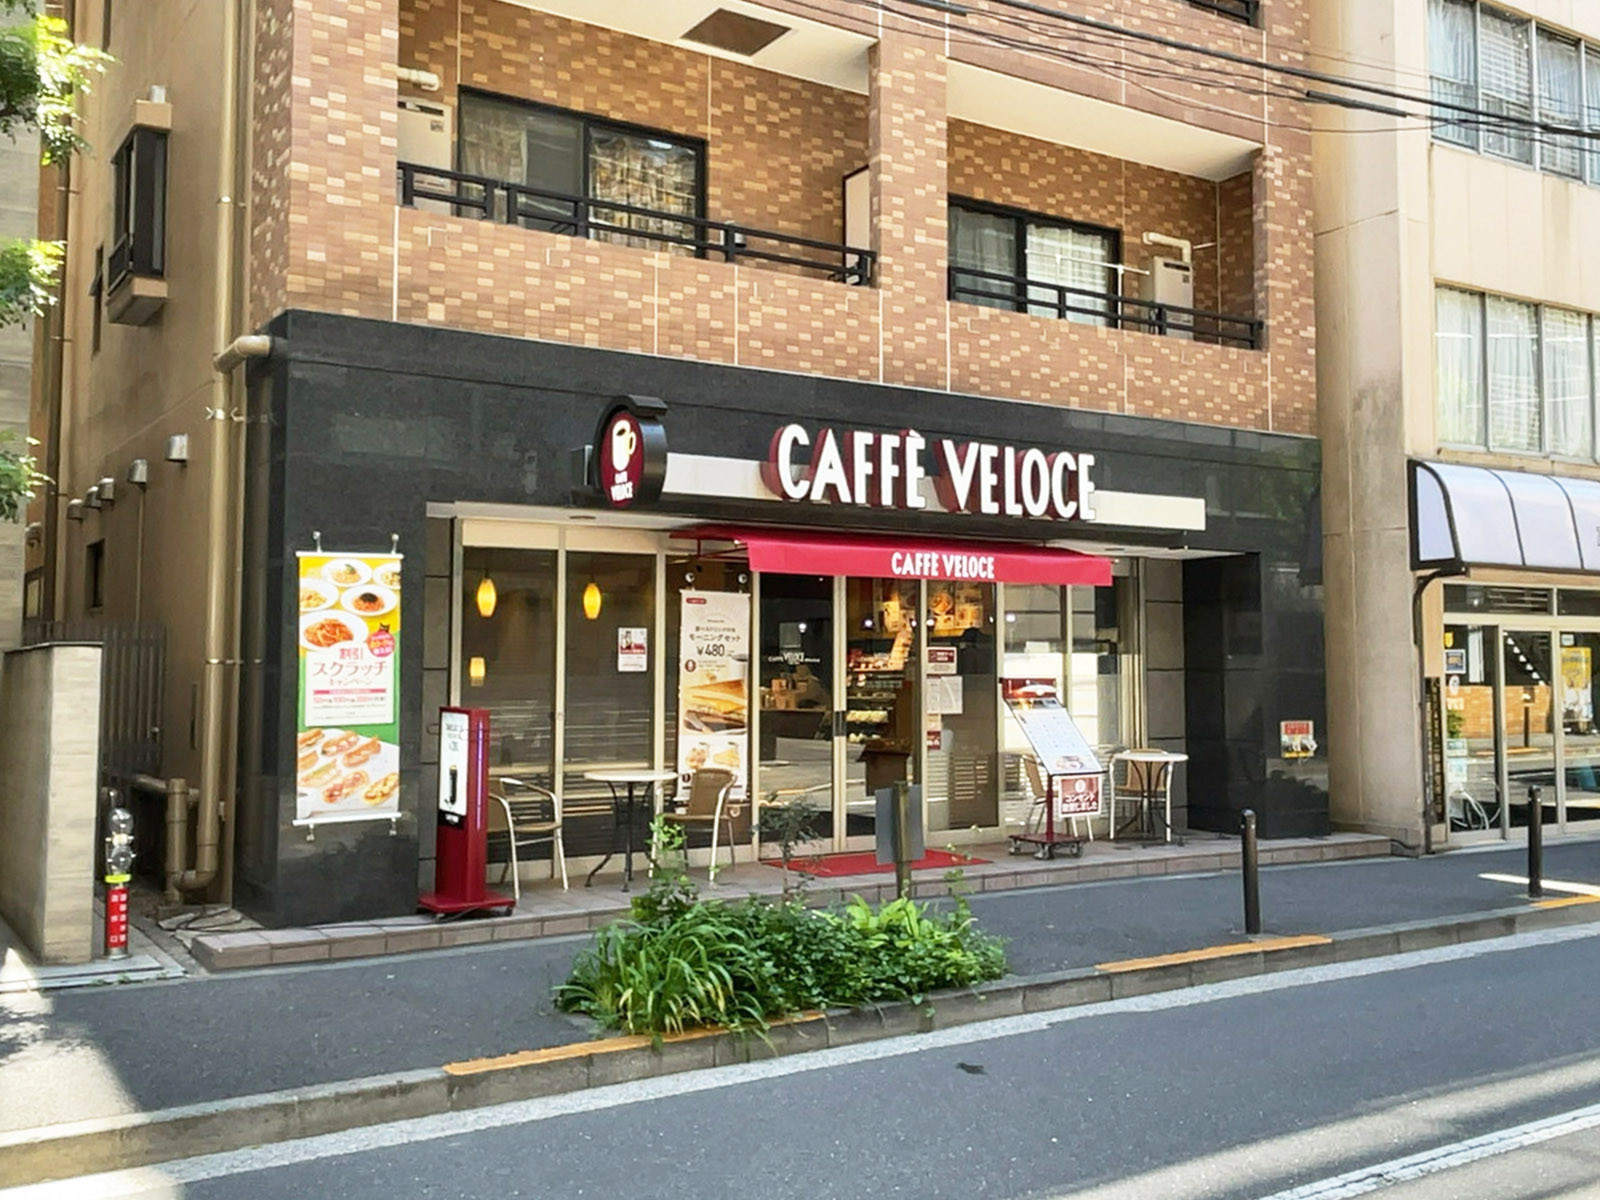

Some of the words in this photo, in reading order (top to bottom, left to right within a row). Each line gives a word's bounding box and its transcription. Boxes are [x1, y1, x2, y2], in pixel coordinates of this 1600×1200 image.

[777, 424, 926, 508] CAFFÈ
[941, 438, 1096, 520] VELOCE
[891, 551, 939, 577] CAFFÈ
[944, 553, 995, 579] VELOCE
[312, 660, 387, 677] スクラッチ
